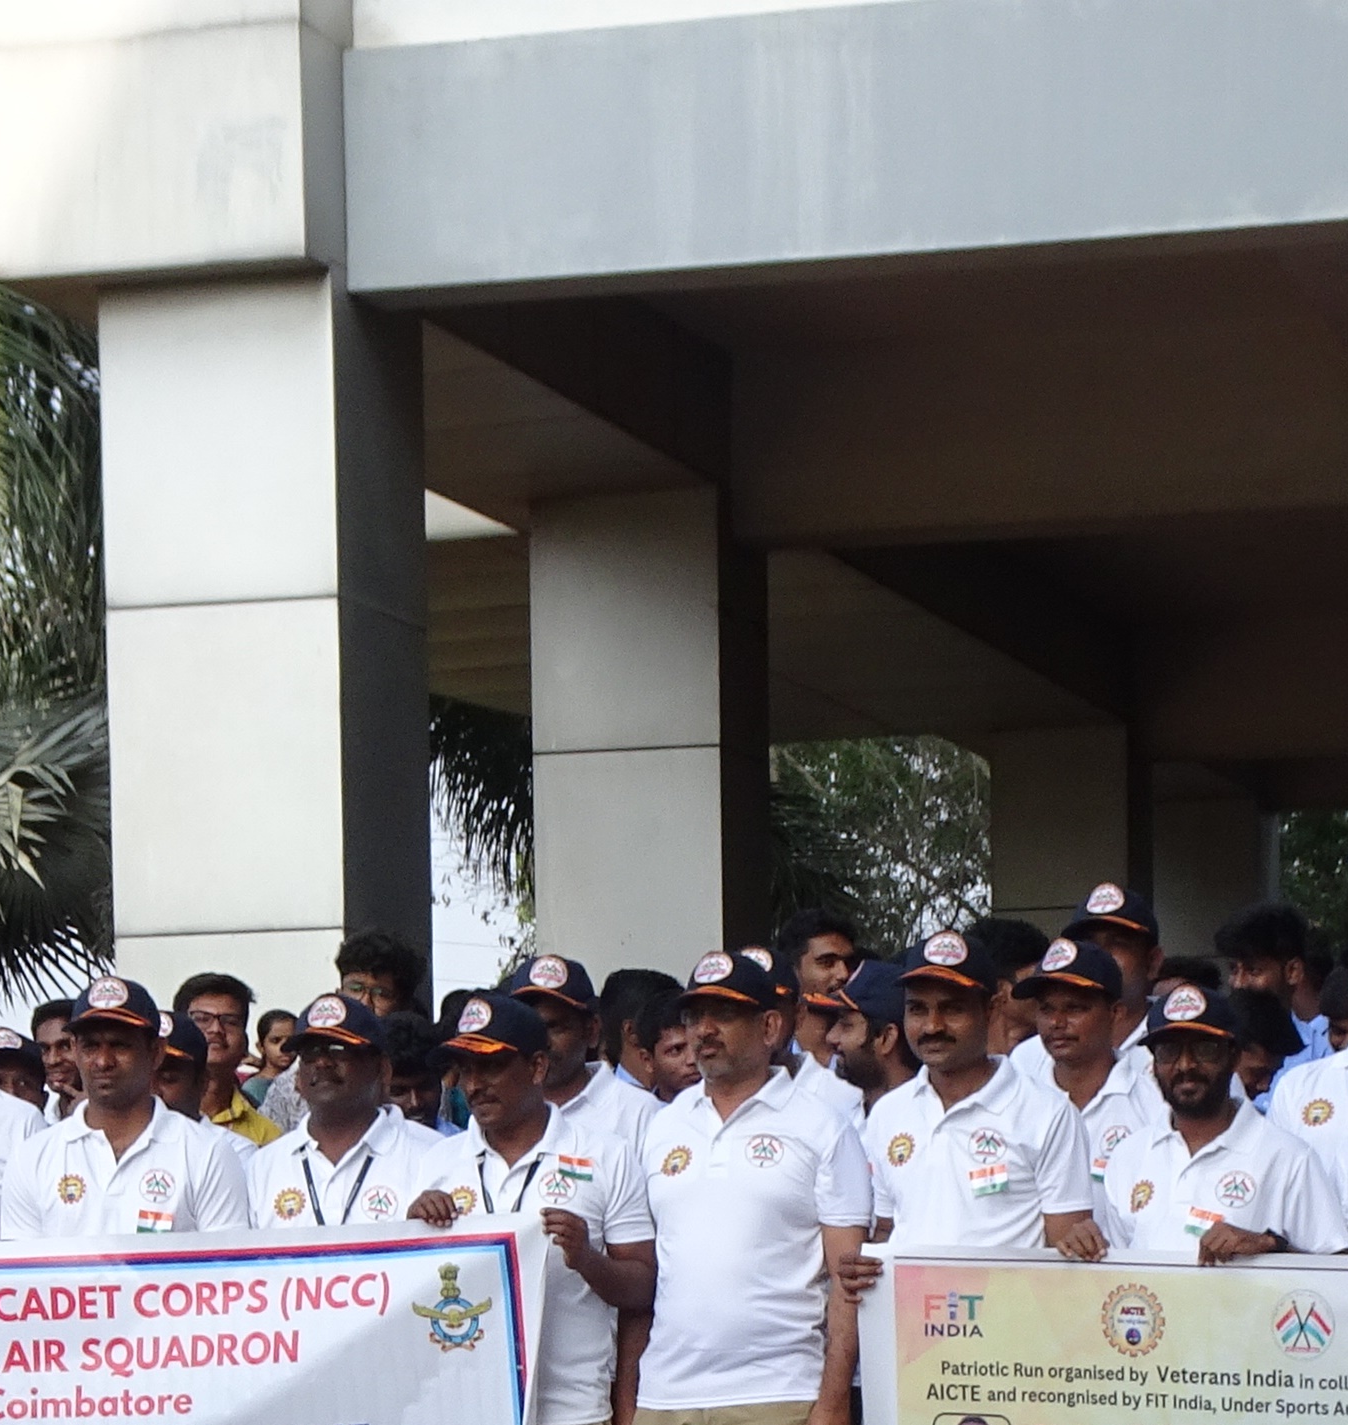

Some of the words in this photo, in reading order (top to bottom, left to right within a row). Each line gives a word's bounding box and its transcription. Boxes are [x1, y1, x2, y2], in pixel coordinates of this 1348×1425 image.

[133, 1279, 268, 1319] CORPS
[280, 1271, 390, 1321] (NCC)
[1119, 1306, 1146, 1316] AICTE
[924, 1323, 984, 1338] INDIA
[2, 1340, 68, 1373] AIR
[80, 1330, 300, 1378] SQUADRON
[941, 1361, 1010, 1378] Patriotic
[1014, 1362, 1044, 1378] Run
[1048, 1364, 1125, 1382] organised
[1129, 1366, 1148, 1386] by
[1157, 1365, 1241, 1386] Veterans
[1247, 1369, 1294, 1388] India
[1299, 1373, 1314, 1389] in
[926, 1384, 981, 1402] AICTE
[987, 1386, 1016, 1402] and
[1021, 1389, 1118, 1408] recongnised
[1122, 1391, 1141, 1410] by
[1145, 1393, 1169, 1409] FIT
[1173, 1395, 1217, 1414] India,
[1221, 1397, 1271, 1413] Under
[1275, 1398, 1329, 1418] Sports
